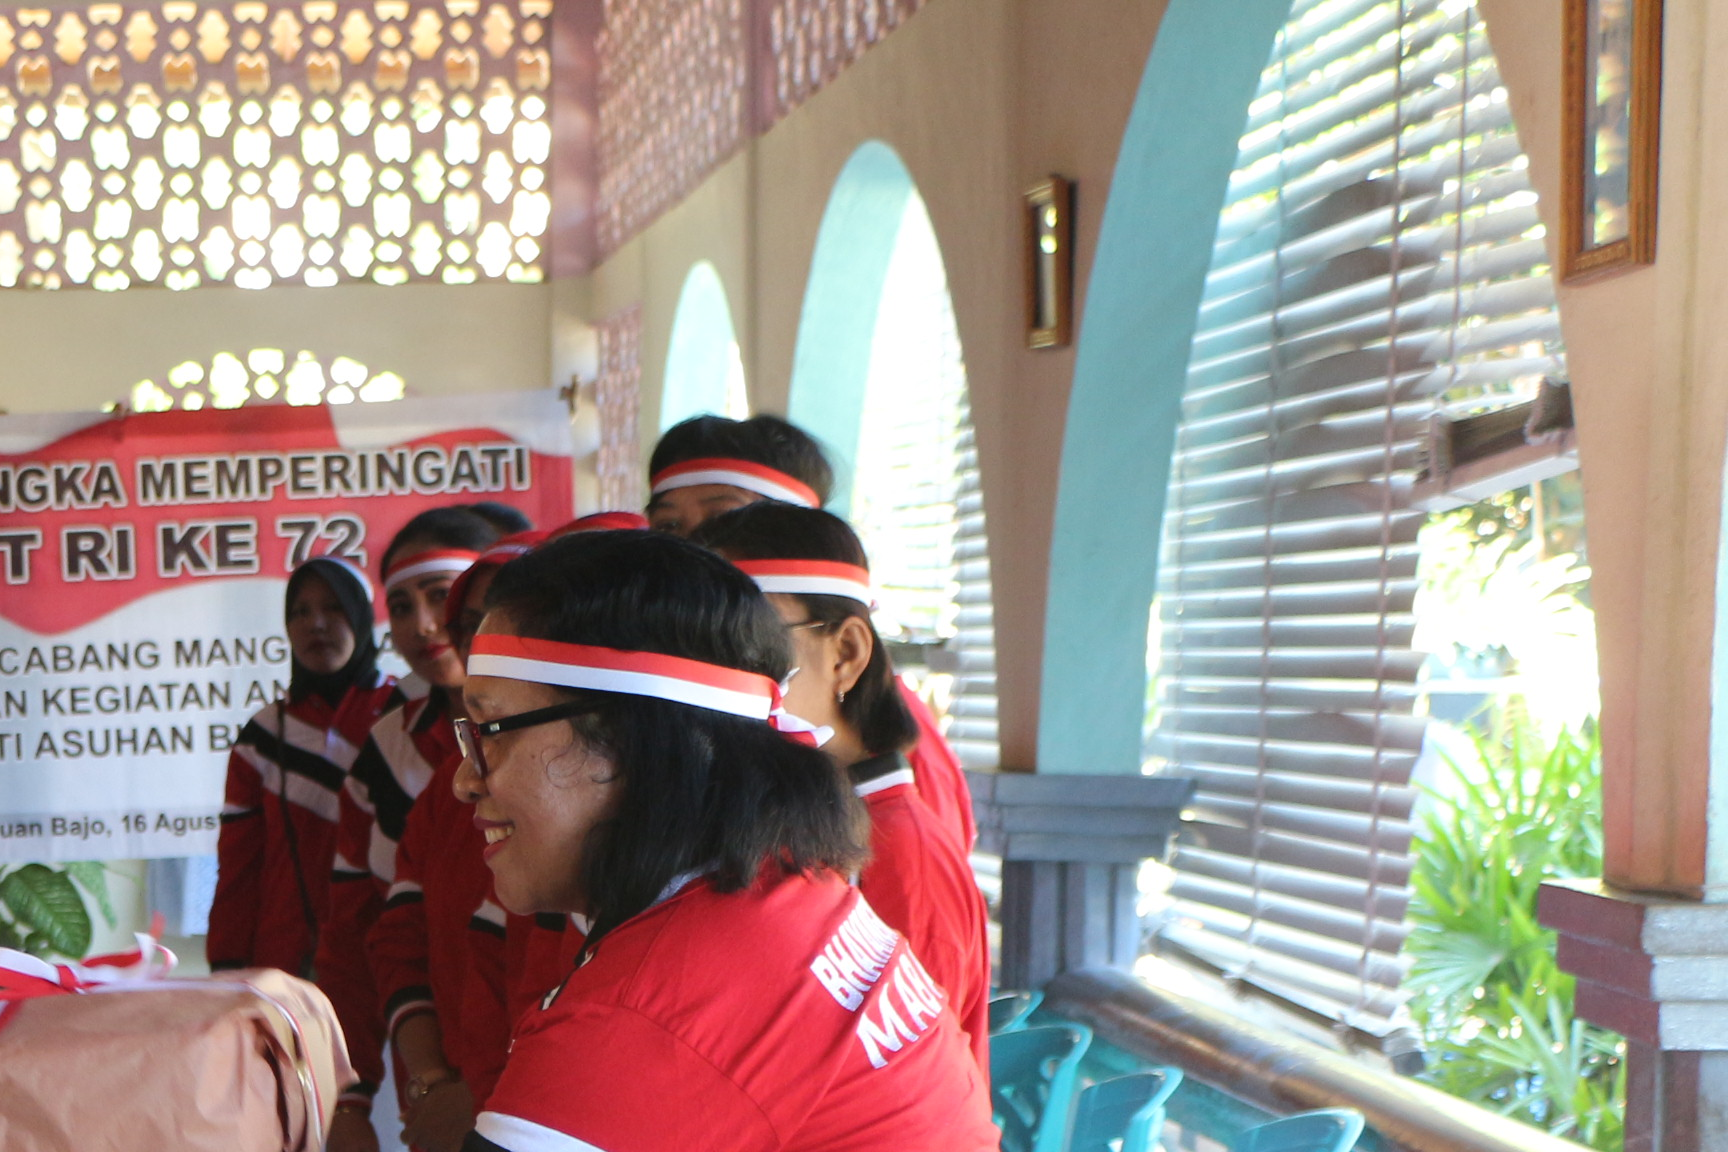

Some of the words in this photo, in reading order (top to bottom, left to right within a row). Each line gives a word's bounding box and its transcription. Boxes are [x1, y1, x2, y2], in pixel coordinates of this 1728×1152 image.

[138, 445, 530, 505] MEMPERINGATI
[60, 523, 135, 581] RI
[156, 517, 259, 577] KE
[276, 513, 367, 571] 72
[174, 636, 290, 669] MANG
[42, 680, 231, 716] KEGIATAN
[35, 726, 193, 760] ASUHAN
[51, 815, 113, 841] Bajo,
[122, 814, 148, 834] 16
